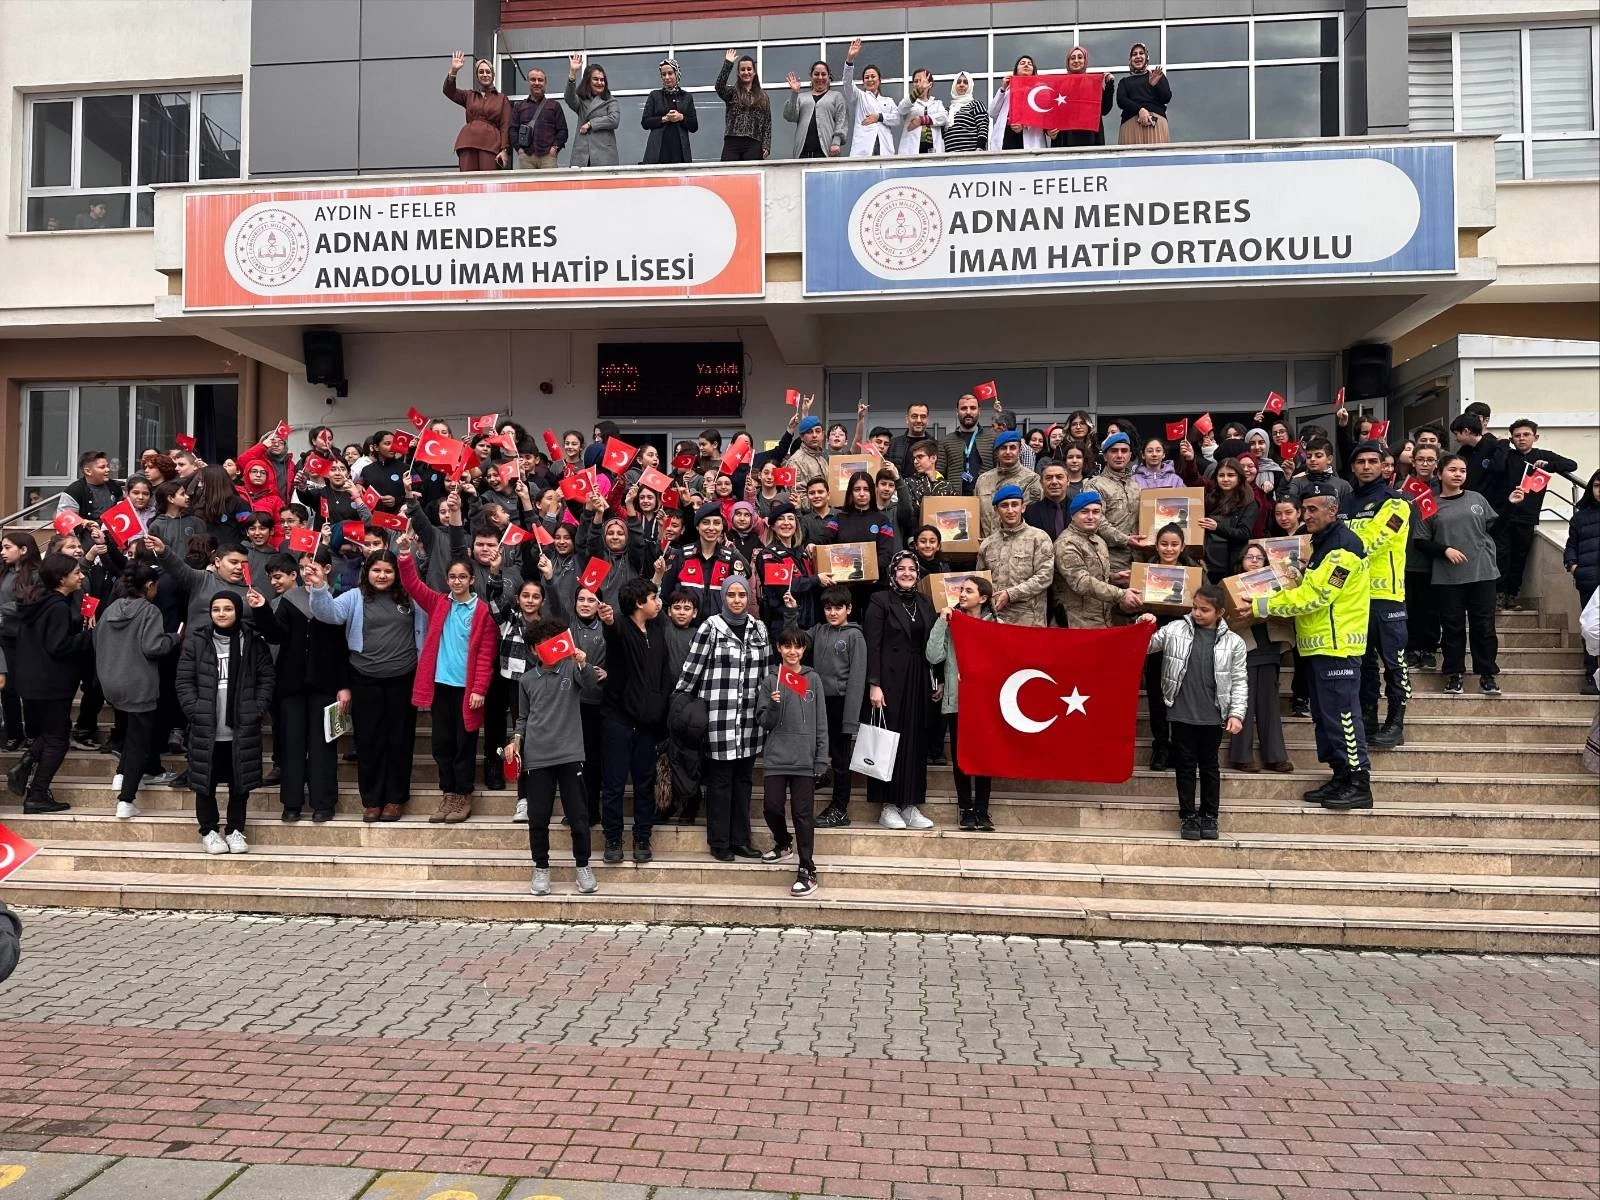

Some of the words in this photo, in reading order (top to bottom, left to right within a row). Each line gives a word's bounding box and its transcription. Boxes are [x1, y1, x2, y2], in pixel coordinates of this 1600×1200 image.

[949, 181, 1012, 199] AYDIN
[1033, 175, 1108, 195] EFELER
[314, 204, 372, 222] AYDIN
[390, 201, 456, 219] EFELER
[948, 206, 1064, 235] ADNAN
[1074, 199, 1251, 229] MENDERES
[314, 230, 408, 254] ADNAN
[416, 225, 558, 251] MENDERES
[949, 244, 1037, 274] İMAM
[1047, 237, 1142, 269] HATİP
[1150, 234, 1352, 265] ORTAOKULU
[314, 264, 442, 289] ANADOLU
[450, 258, 524, 285] İMAM
[532, 254, 609, 283] HATİP
[616, 252, 694, 282] LİSESİ
[696, 363, 712, 374] Ya
[695, 385, 711, 397] ya
